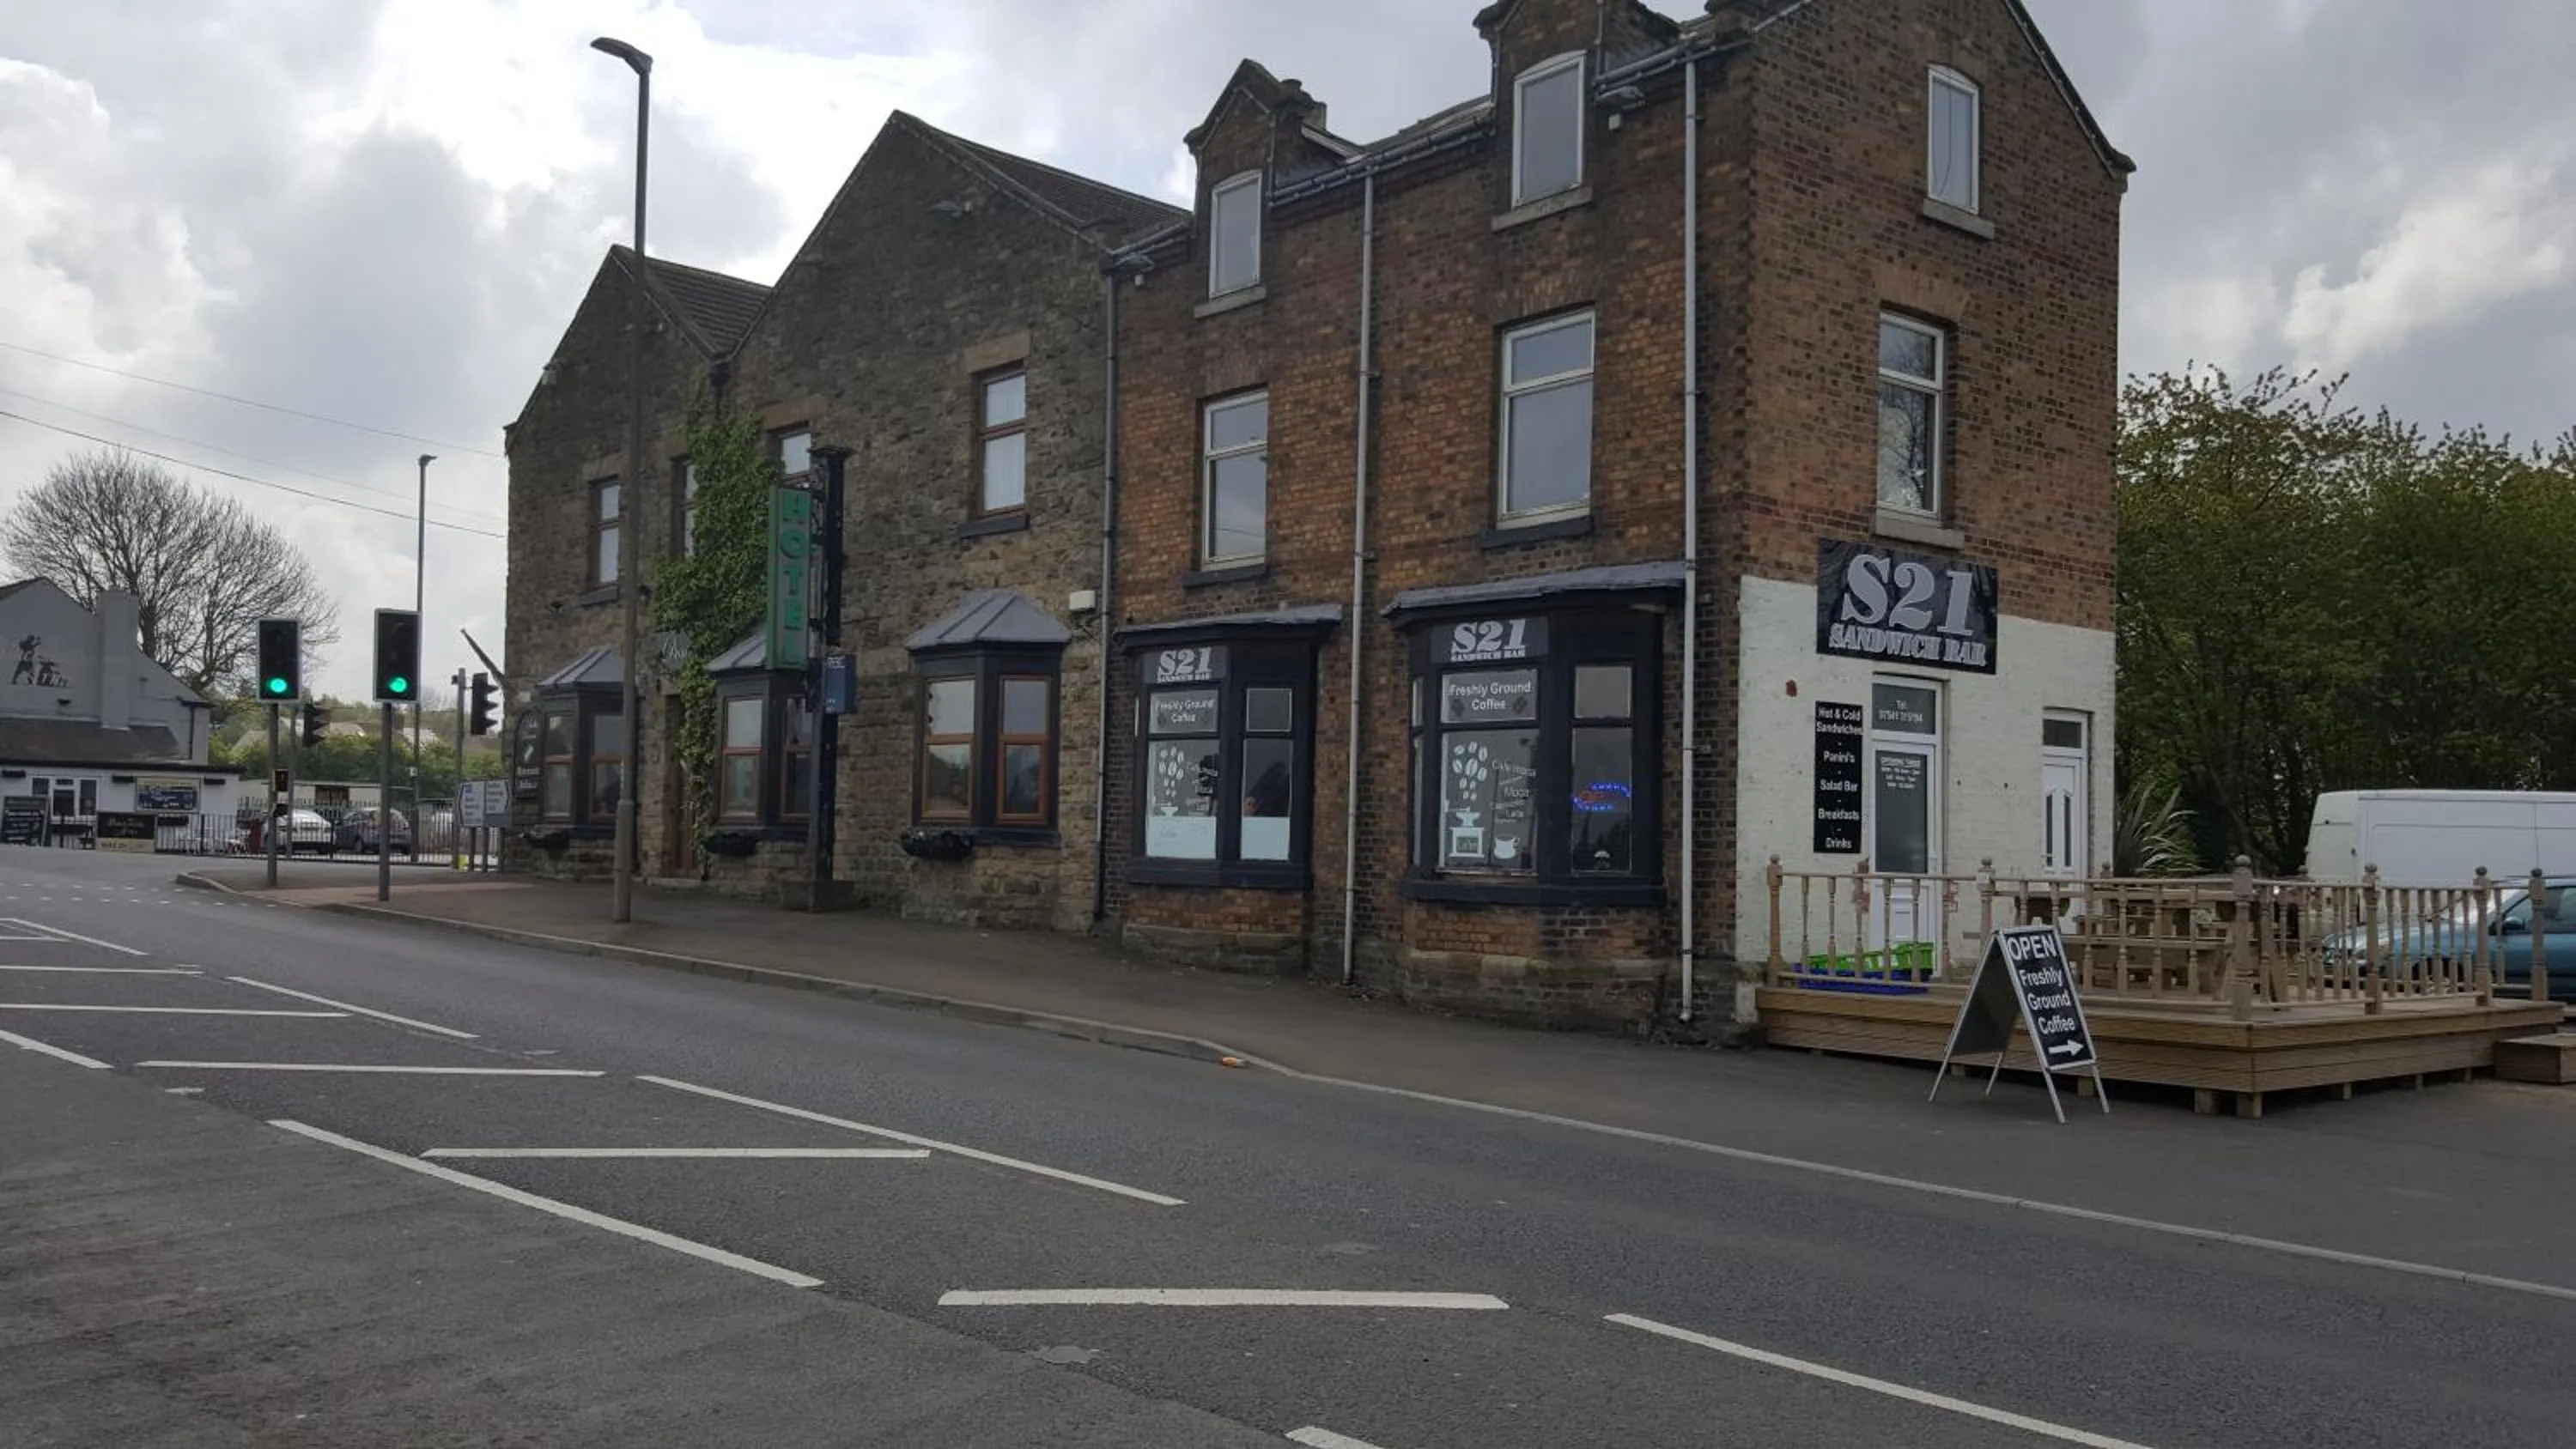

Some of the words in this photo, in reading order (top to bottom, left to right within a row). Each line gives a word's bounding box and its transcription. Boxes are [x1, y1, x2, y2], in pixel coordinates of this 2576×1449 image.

[1841, 554, 1972, 635] S21
[1451, 619, 1526, 652] S21
[1829, 622, 1941, 660] SANDWICH
[1943, 638, 1987, 666] BAR
[1157, 647, 1212, 676] S21
[1449, 683, 1488, 697] Freshly
[1490, 680, 1532, 694] Ground
[1471, 698, 1506, 711] Coffee
[1818, 707, 1833, 718] Hot
[1834, 708, 1841, 719] &
[1842, 710, 1861, 721] Cold
[1816, 721, 1862, 736] Sandwiches
[1823, 750, 1856, 763] Panini's
[1820, 779, 1843, 791] Salad
[1844, 780, 1858, 792] Bar
[1818, 808, 1860, 821] Breakfasts
[1825, 837, 1852, 849] Drinks
[2007, 934, 2057, 961] OPEN
[2019, 967, 2063, 986] Freshly
[2027, 990, 2071, 1010] Ground
[2038, 1015, 2075, 1034] Coffee
